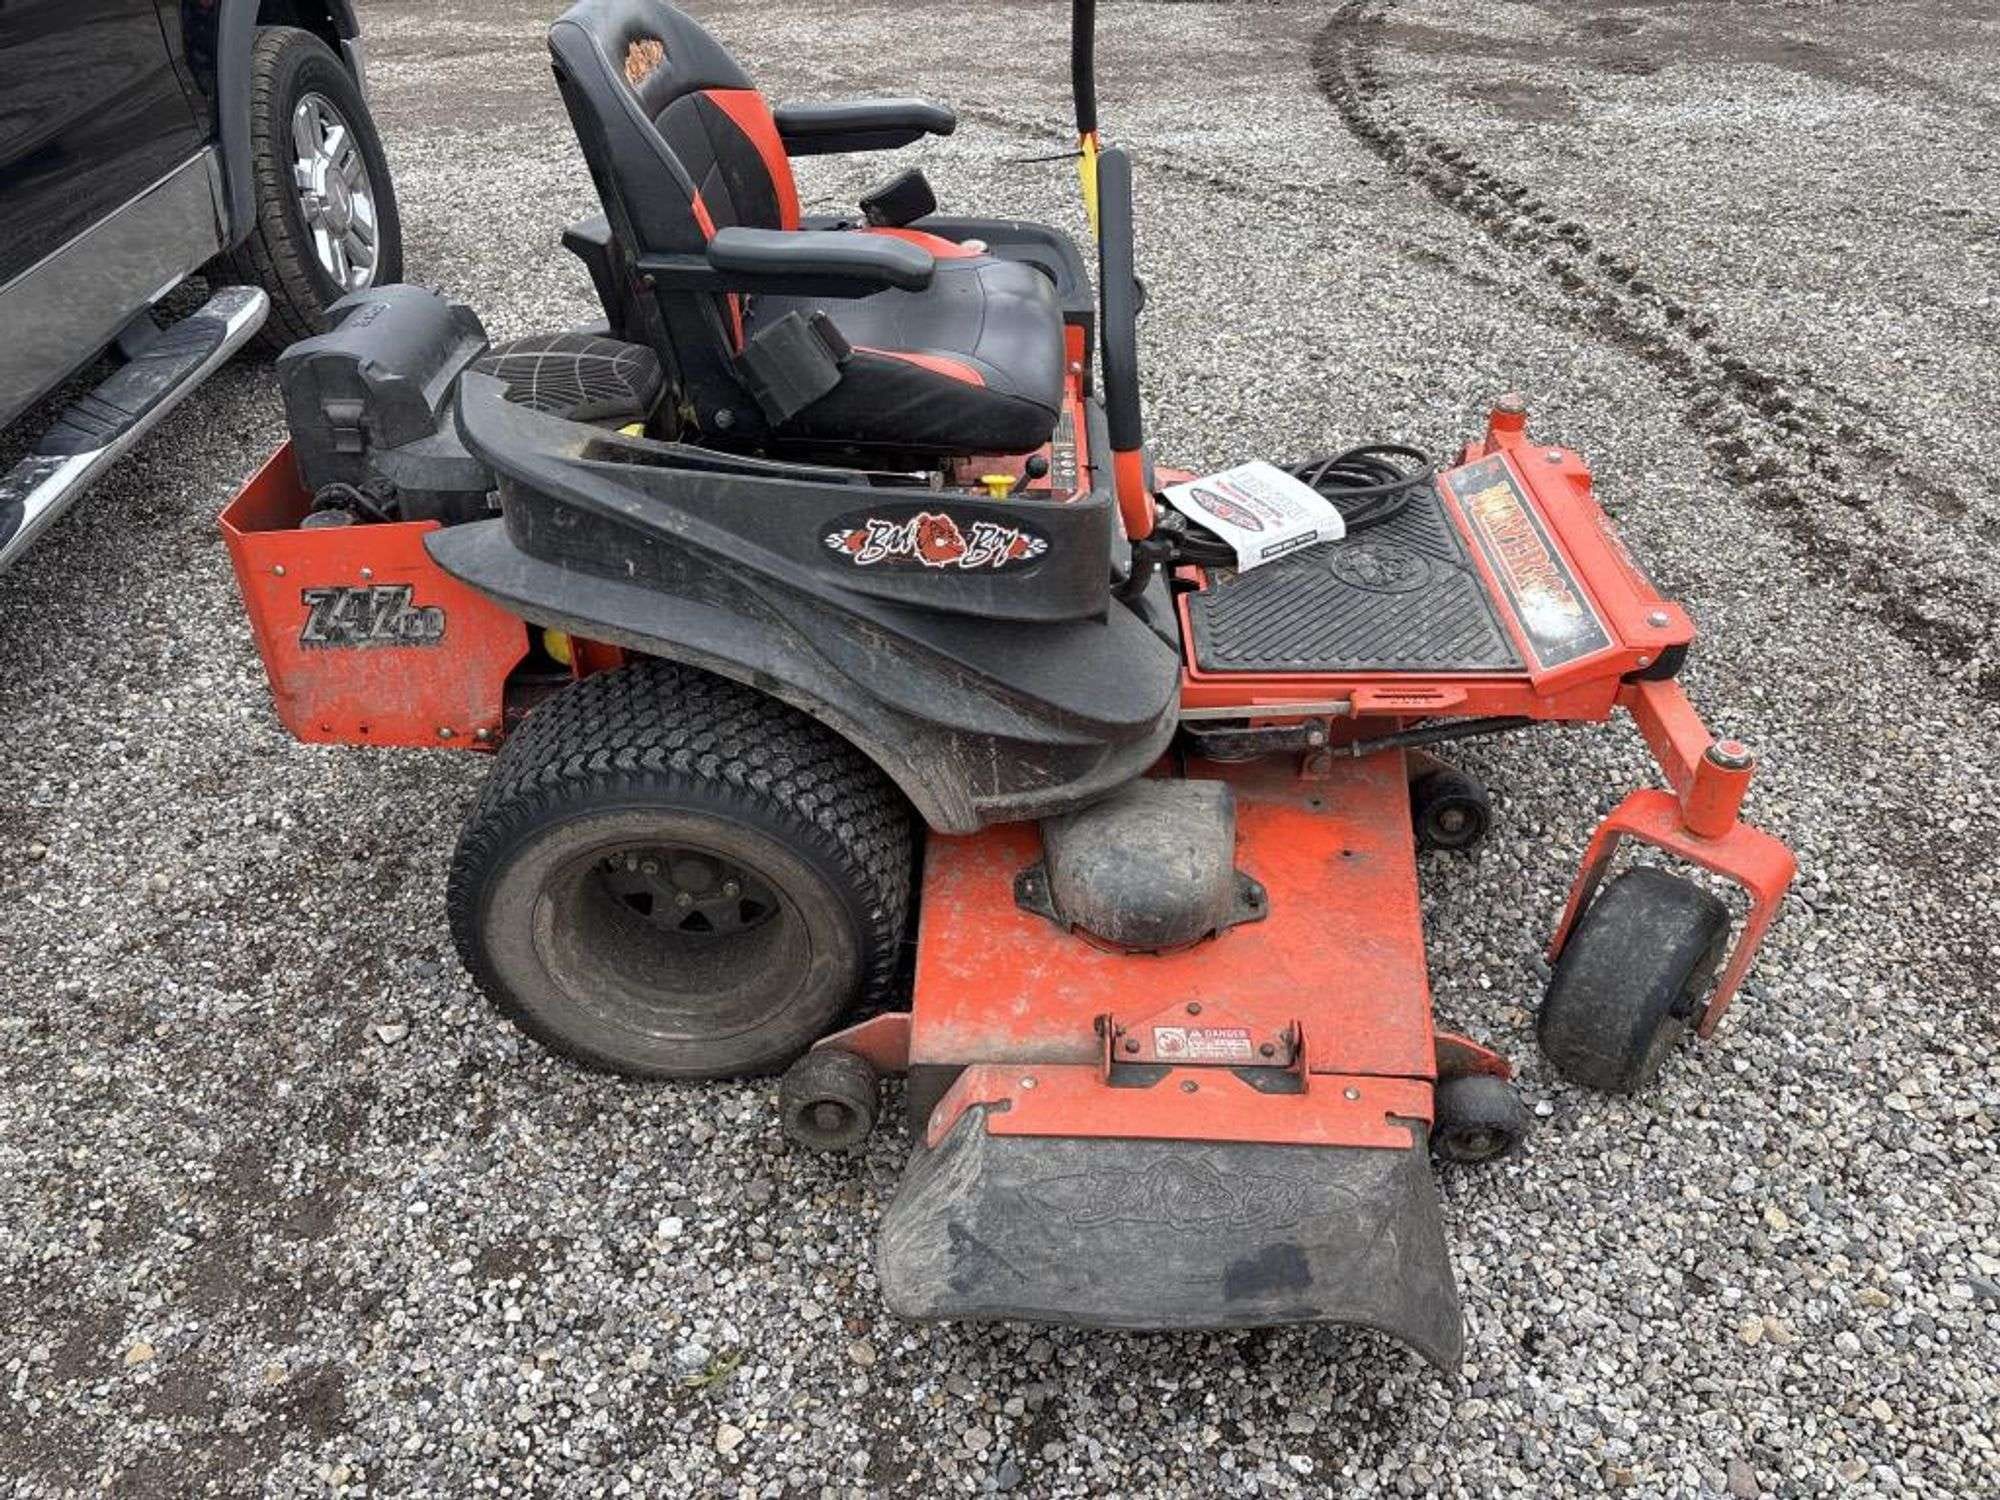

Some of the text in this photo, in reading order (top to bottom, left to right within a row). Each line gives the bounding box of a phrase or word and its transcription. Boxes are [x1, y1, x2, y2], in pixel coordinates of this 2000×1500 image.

[854, 517, 1020, 568] Bad Boy
[1203, 1029, 1248, 1038] DANGER
